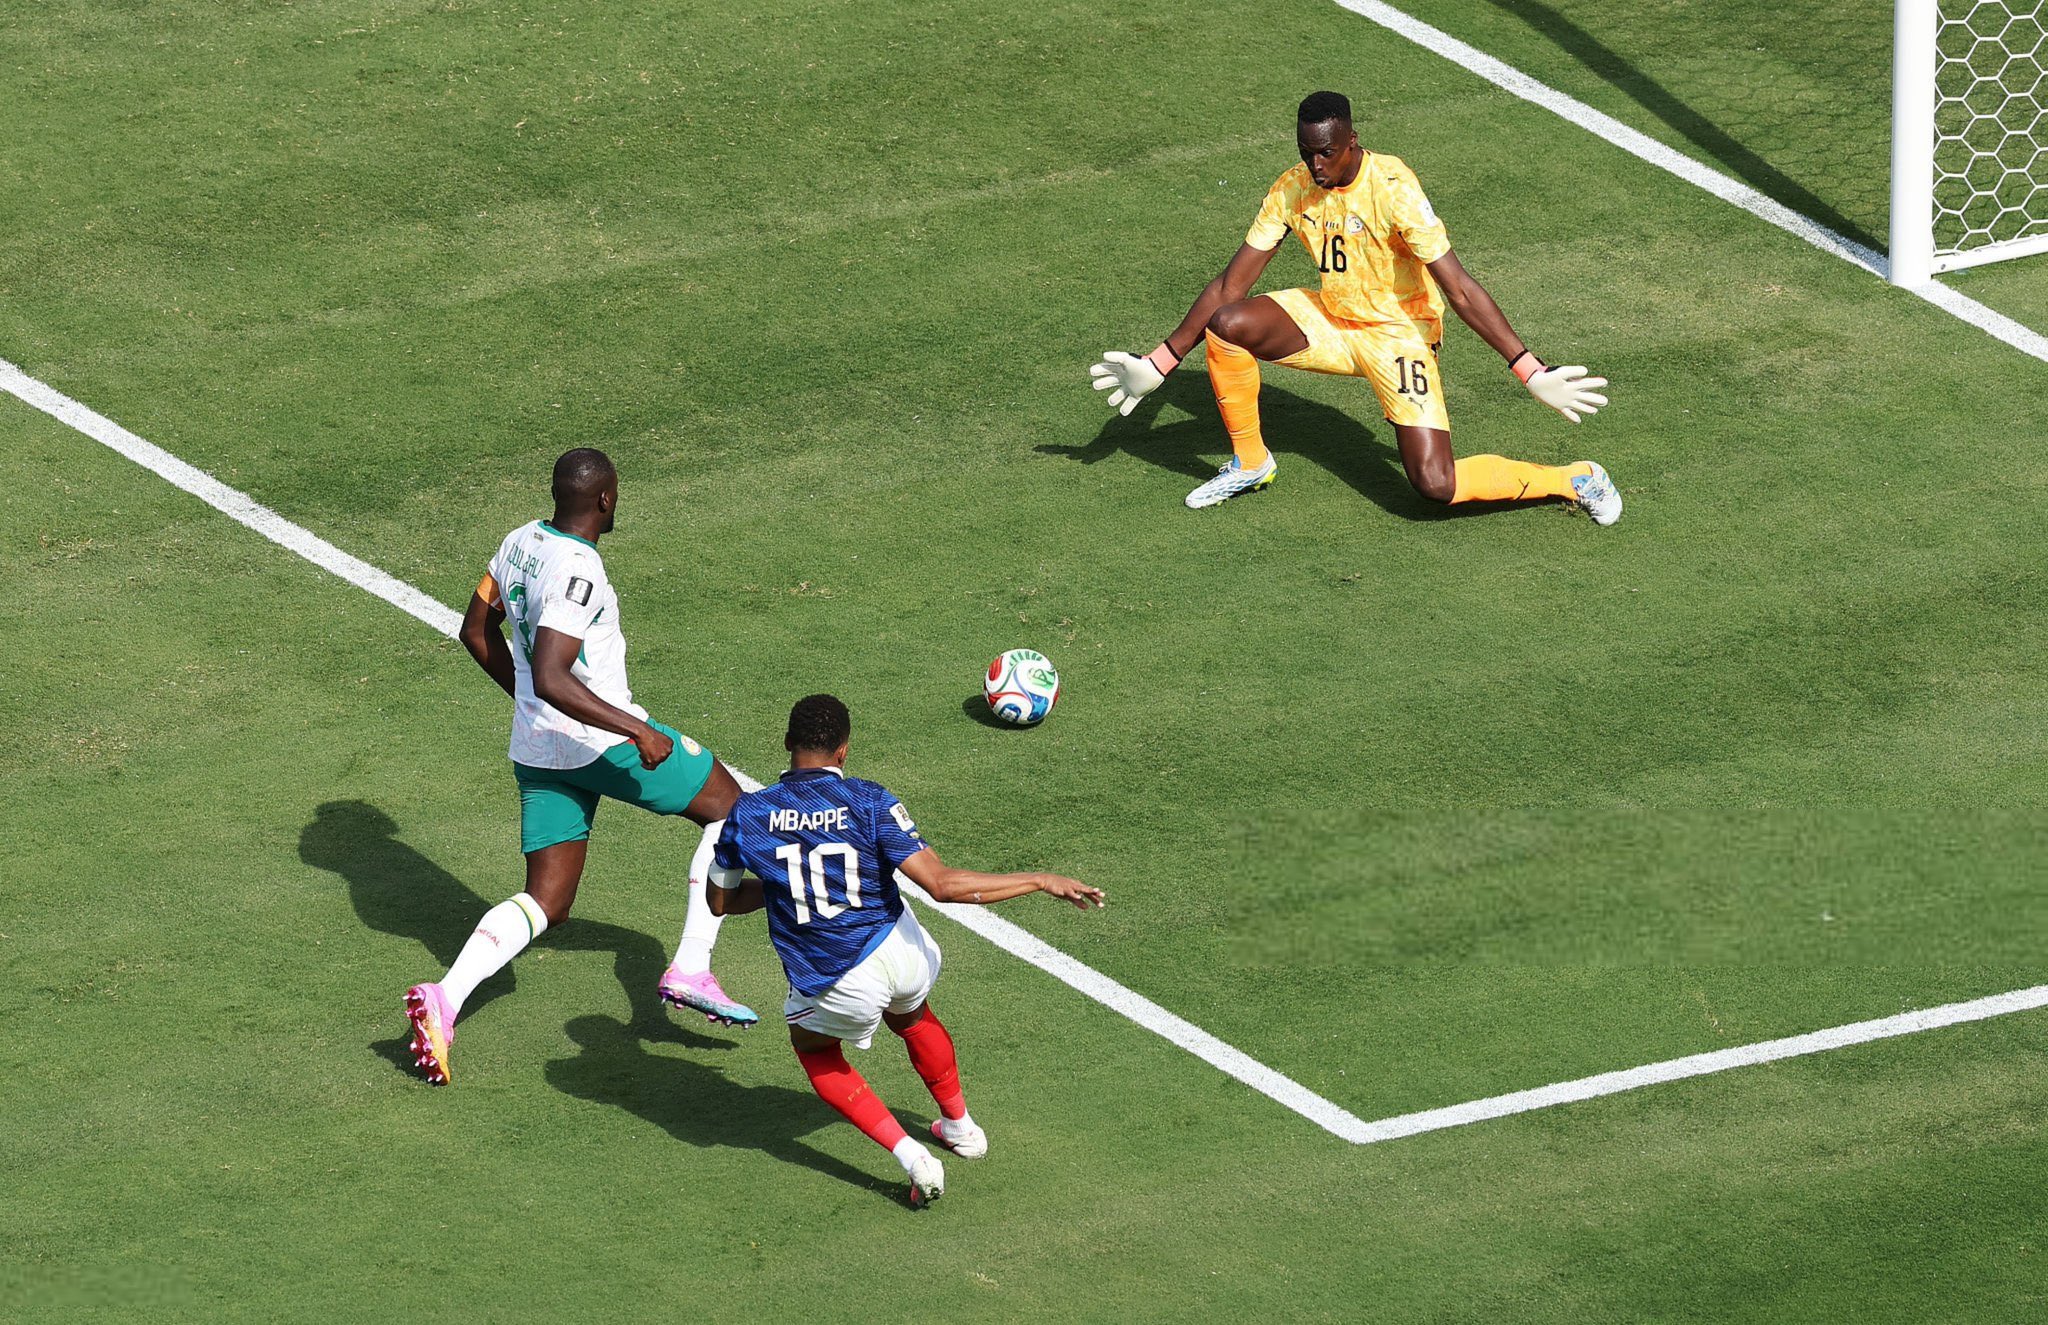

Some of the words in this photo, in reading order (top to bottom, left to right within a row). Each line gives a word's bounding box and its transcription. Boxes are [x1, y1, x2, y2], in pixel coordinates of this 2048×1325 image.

[1319, 234, 1347, 273] 16
[1395, 356, 1428, 395] 16
[769, 806, 849, 832] MBAPPE
[775, 842, 863, 925] 10
